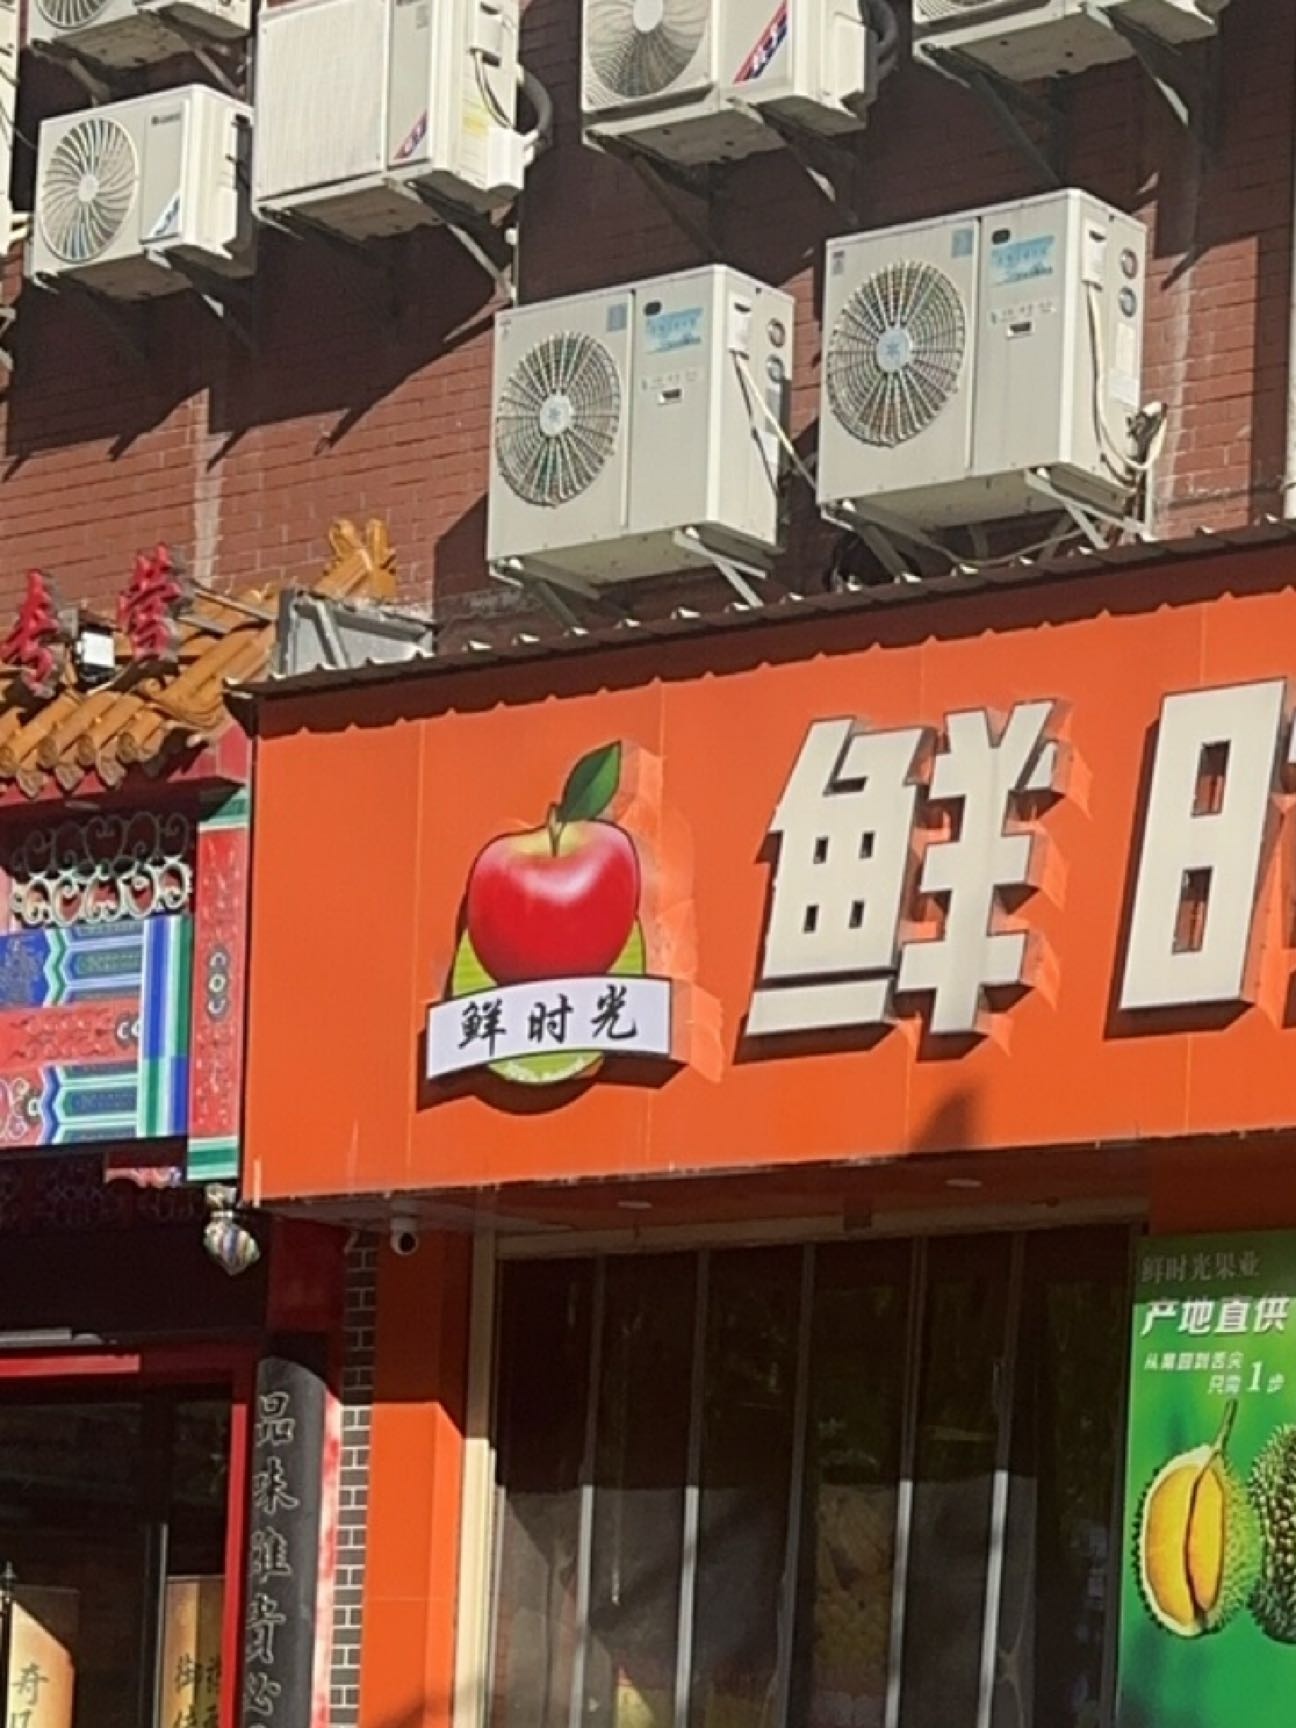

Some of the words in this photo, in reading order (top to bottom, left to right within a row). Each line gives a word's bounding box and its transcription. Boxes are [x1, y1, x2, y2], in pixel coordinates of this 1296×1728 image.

[456, 983, 639, 1058] 鲜时光
[1140, 1249, 1262, 1285] 鲜时光果业
[1139, 1293, 1290, 1339] 产地直供
